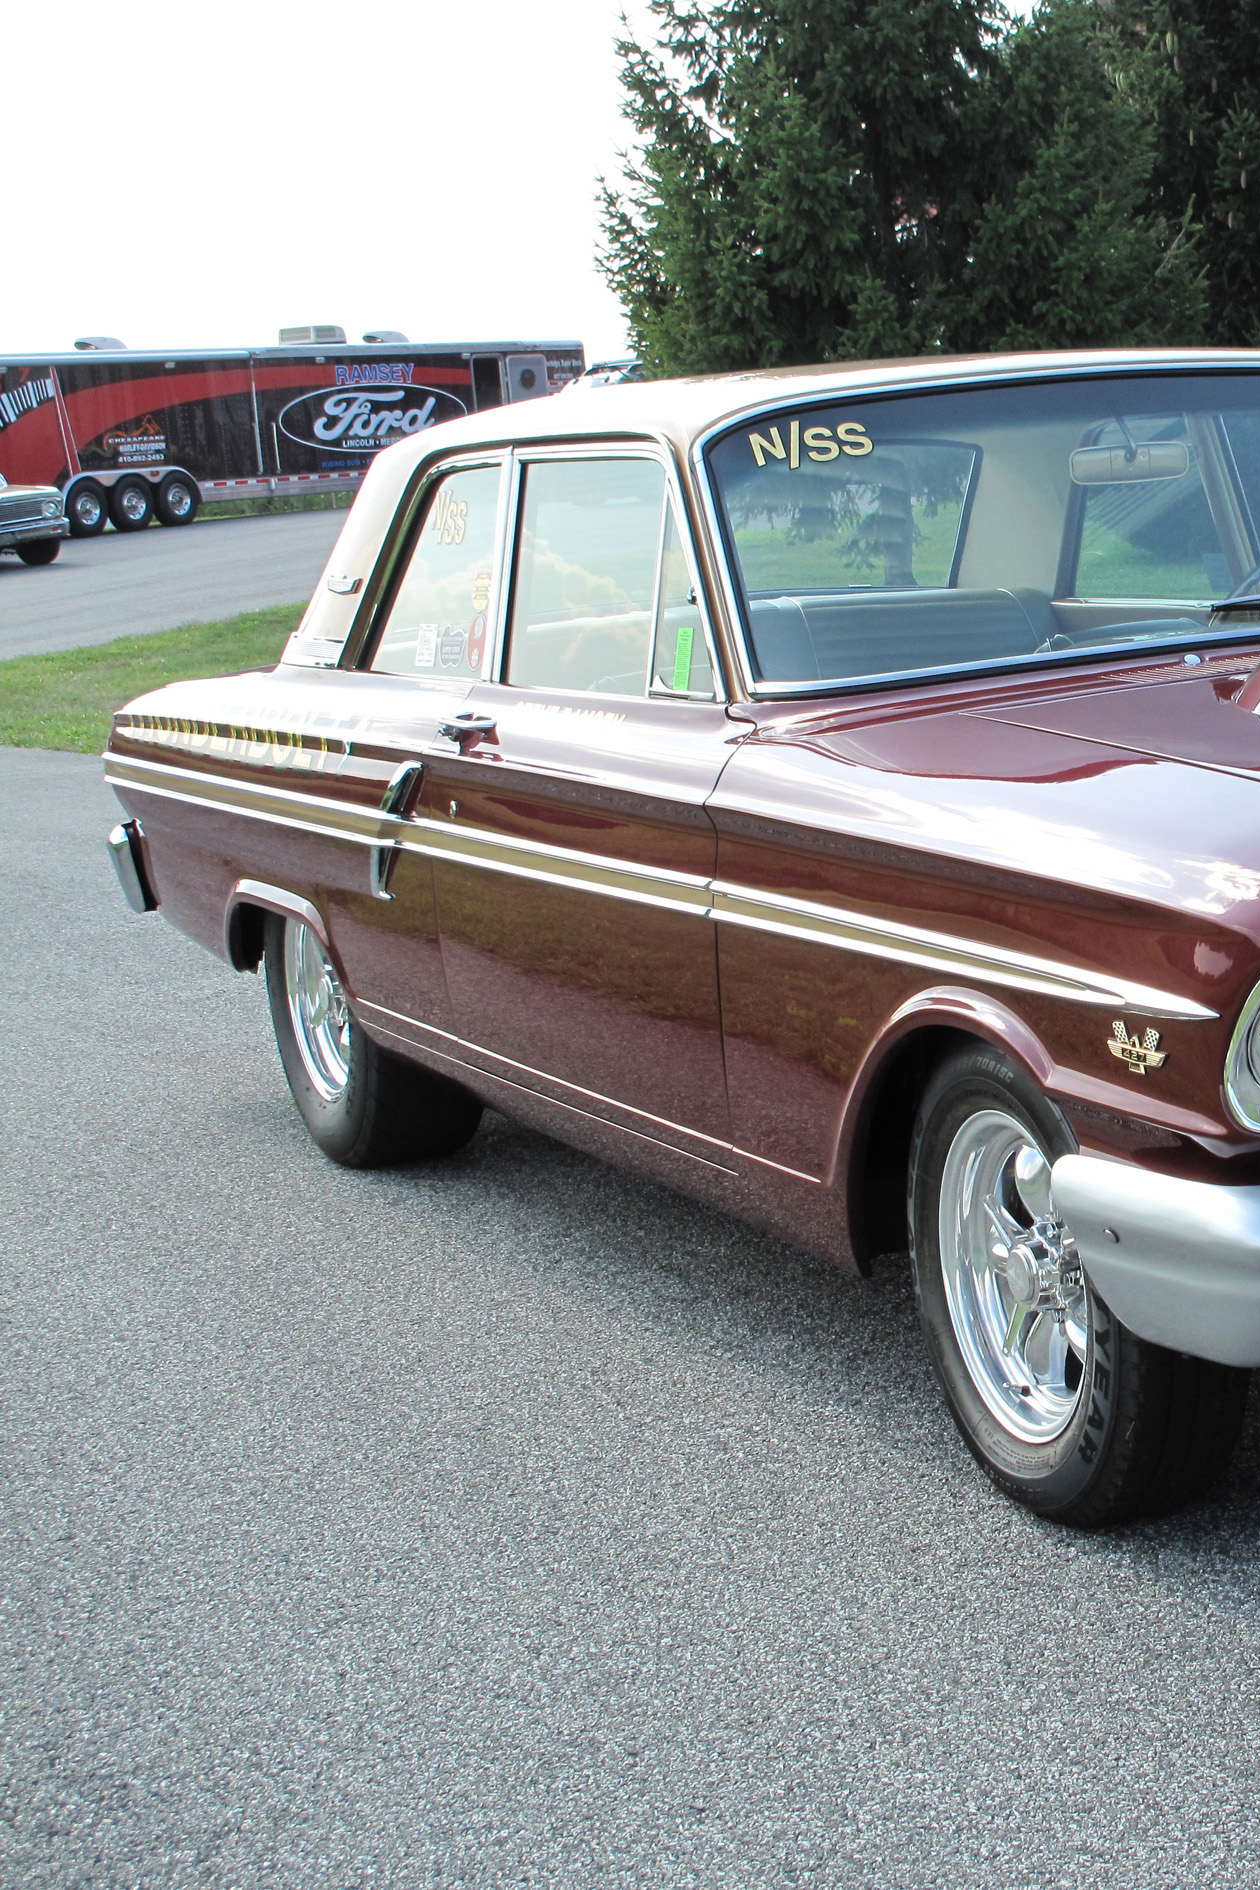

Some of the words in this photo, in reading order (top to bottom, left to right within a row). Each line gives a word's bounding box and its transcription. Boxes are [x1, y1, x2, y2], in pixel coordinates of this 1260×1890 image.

[335, 363, 415, 385] RAMSEY
[314, 390, 436, 441] Ford
[342, 438, 375, 448] LINCOLN
[747, 420, 874, 470] N/SS
[346, 459, 361, 467] SUN
[1122, 1050, 1145, 1062] 427
